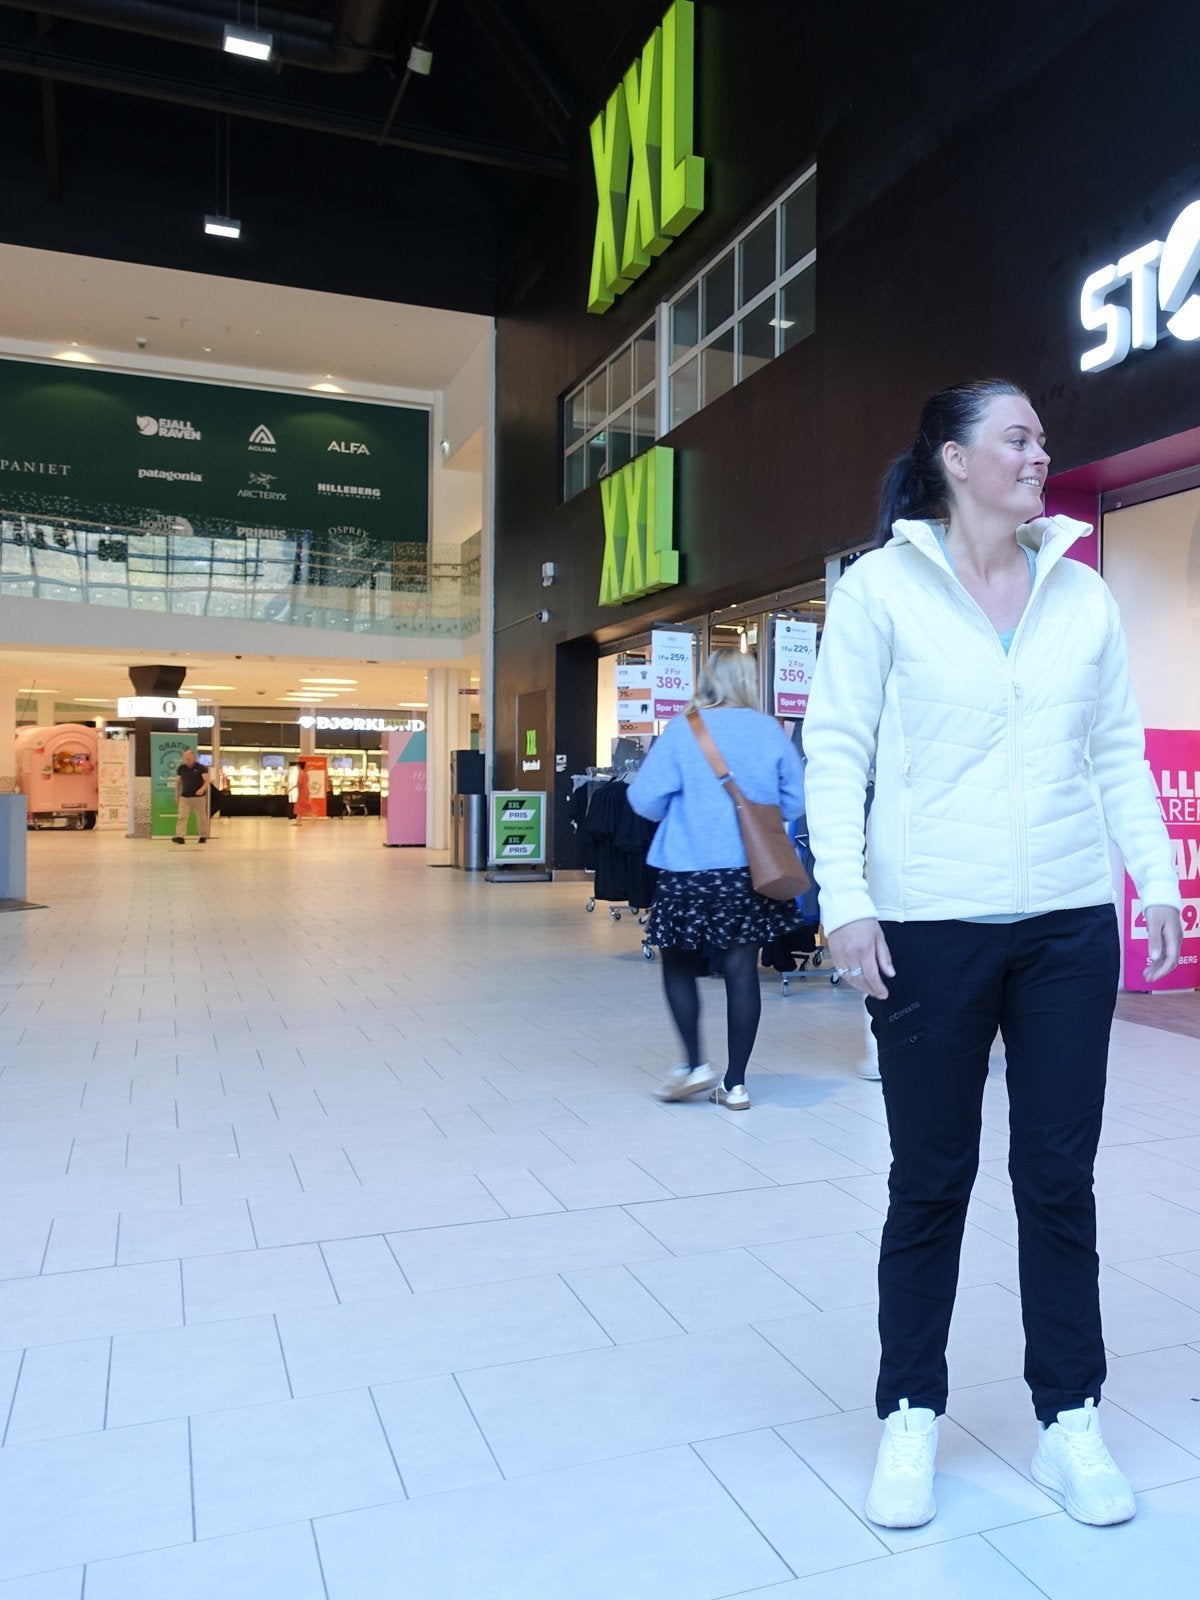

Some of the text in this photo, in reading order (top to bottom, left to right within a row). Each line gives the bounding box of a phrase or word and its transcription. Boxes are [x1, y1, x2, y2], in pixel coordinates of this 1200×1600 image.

[587, 0, 704, 314] XXL
[248, 445, 276, 453] ACLIMA
[327, 440, 370, 455] ALFA
[0, 459, 71, 475] PANIET
[138, 469, 202, 482] patagonia
[318, 483, 381, 497] HILLEBERG
[236, 526, 288, 540] PRIMUS
[328, 526, 368, 538] OSPREY
[598, 445, 679, 607] XXL
[509, 811, 528, 819] PRIS
[1146, 956, 1198, 966] SBERG
